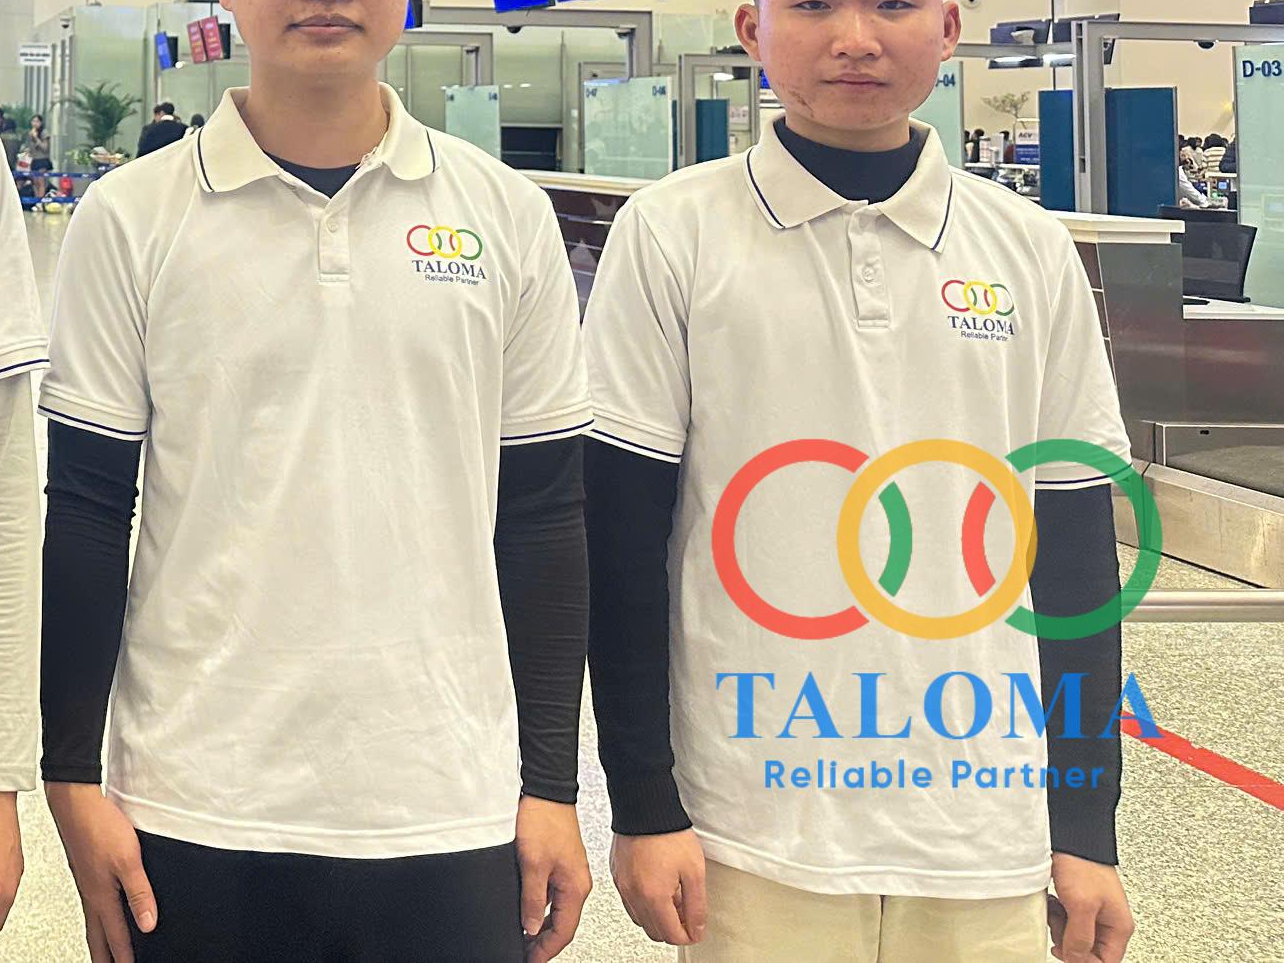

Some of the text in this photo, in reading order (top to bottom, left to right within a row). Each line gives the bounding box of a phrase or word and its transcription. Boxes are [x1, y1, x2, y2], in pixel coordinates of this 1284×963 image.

[1242, 60, 1282, 77] D-03
[935, 73, 956, 87] -04
[412, 260, 487, 280] TALOMA
[425, 274, 479, 286] Reliable Partner
[961, 330, 989, 340] Reliable
